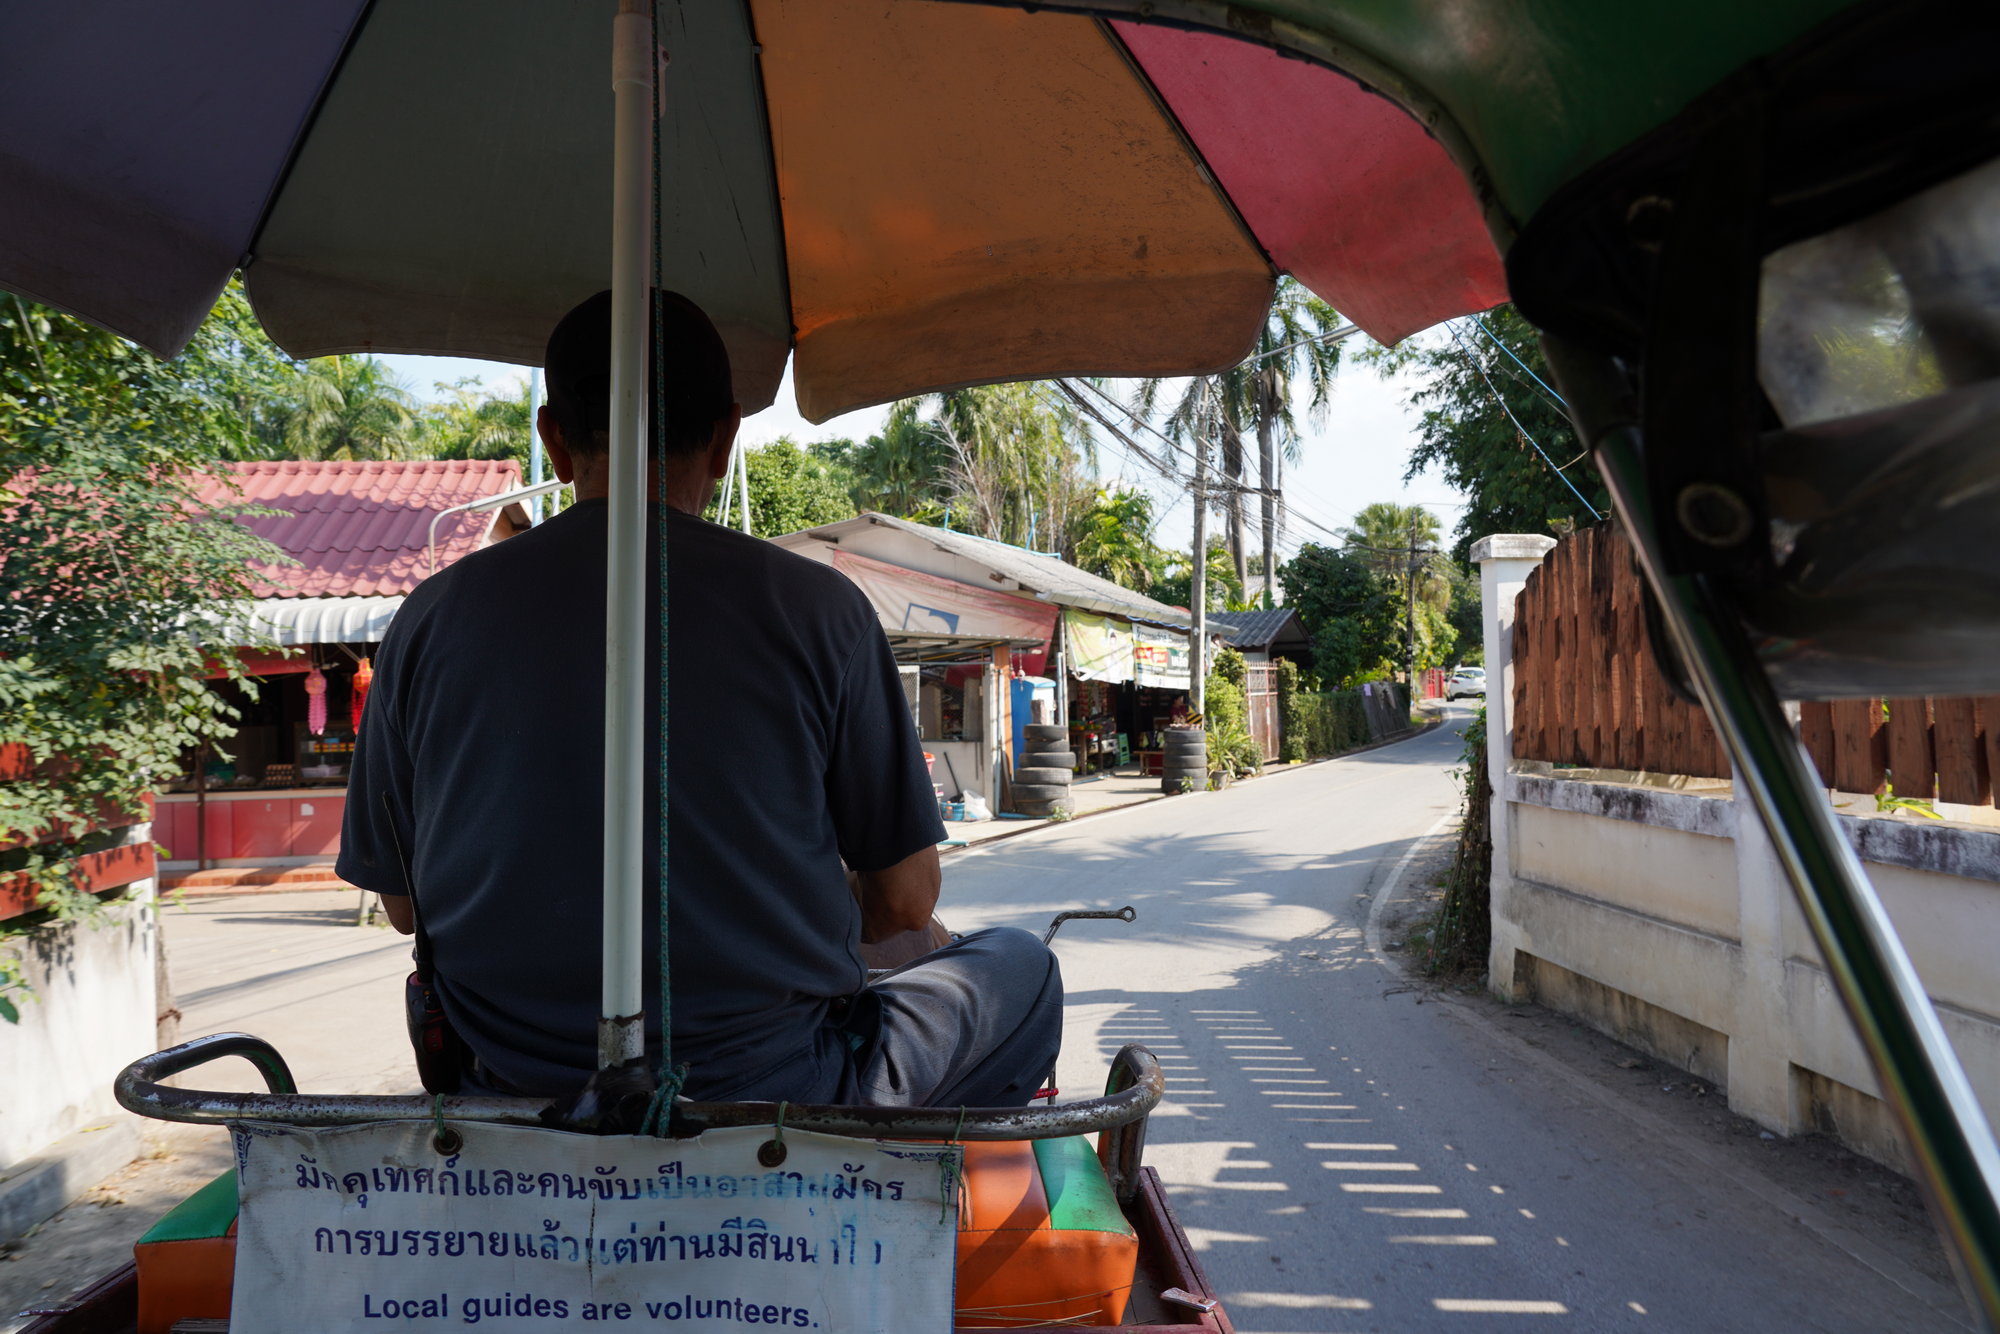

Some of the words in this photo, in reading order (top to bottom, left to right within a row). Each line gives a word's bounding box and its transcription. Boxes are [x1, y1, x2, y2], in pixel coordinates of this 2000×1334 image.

[364, 1293, 448, 1319] Local
[462, 1293, 569, 1324] guides
[582, 1302, 632, 1321] are
[645, 1295, 820, 1329] volunteers.
